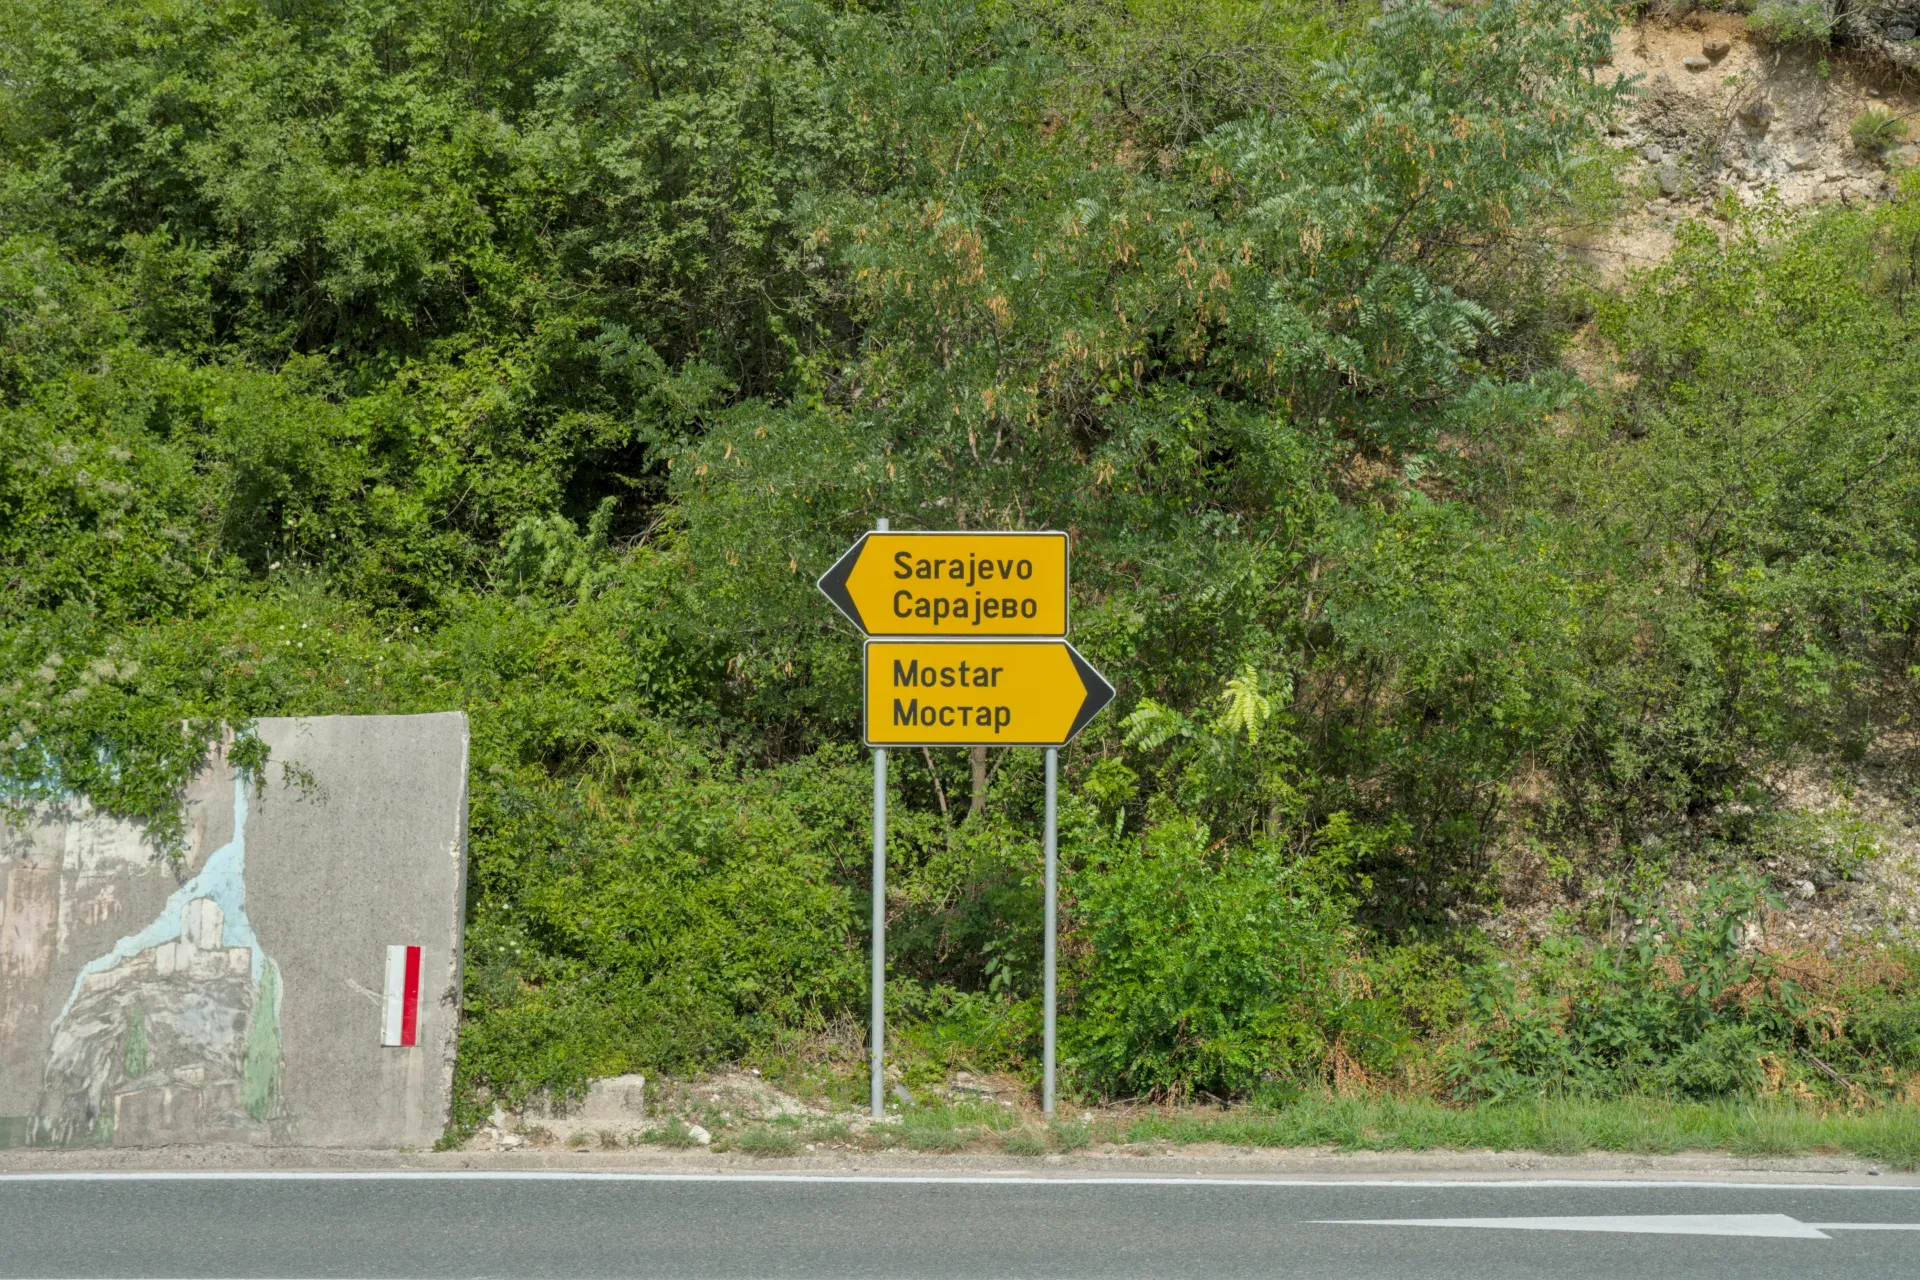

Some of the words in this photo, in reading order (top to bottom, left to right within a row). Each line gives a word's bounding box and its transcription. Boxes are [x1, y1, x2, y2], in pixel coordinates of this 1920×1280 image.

[893, 551, 1033, 587] Sarajevo
[893, 590, 1037, 626] Сарајево
[893, 659, 1004, 687] Mostar
[893, 698, 1011, 734] Мостар
